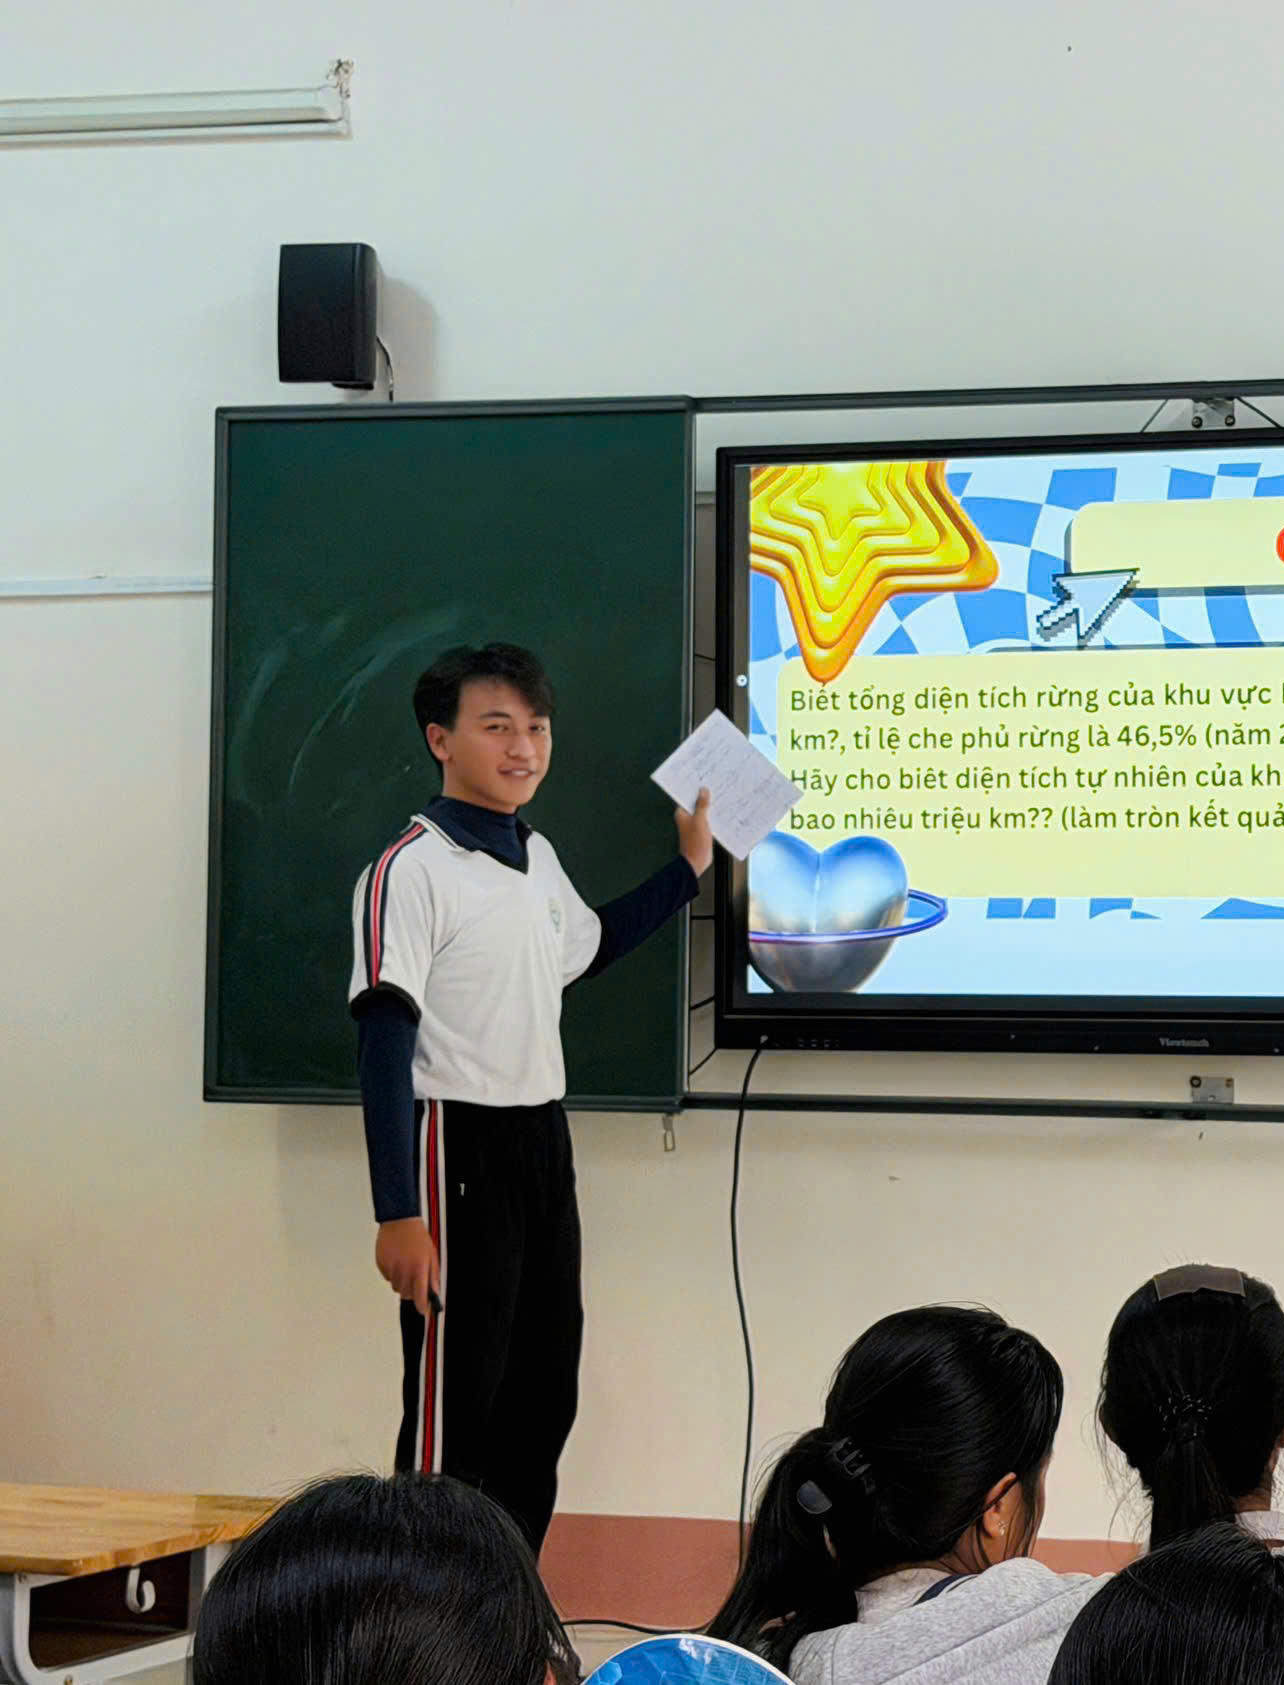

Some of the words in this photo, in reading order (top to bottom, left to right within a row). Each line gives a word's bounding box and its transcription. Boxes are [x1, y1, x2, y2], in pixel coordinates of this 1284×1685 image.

[848, 685, 905, 715] tổng
[914, 687, 969, 715] diện
[978, 687, 1026, 709] tích
[1037, 685, 1099, 713] rừng
[1108, 681, 1155, 706] của
[1165, 683, 1210, 706] khu
[1220, 685, 1272, 710] vực
[791, 729, 846, 755] km?,
[853, 726, 872, 749] tỉ
[879, 727, 900, 755] lệ
[908, 727, 953, 750] che
[961, 724, 1010, 754] phủ
[1018, 726, 1080, 754] rừng
[1088, 724, 1110, 747] là
[1117, 724, 1197, 751] 46,5%
[1205, 723, 1270, 748] (năm
[791, 769, 838, 796] Hãy
[845, 768, 890, 790] cho
[956, 767, 1011, 794] diện
[1019, 766, 1067, 789] tích
[1075, 768, 1107, 794] tự
[1114, 765, 1186, 788] nhiên
[1196, 762, 1243, 787] của
[791, 808, 835, 830] bao
[844, 808, 913, 830] nhiêu
[921, 807, 981, 834] triệu
[990, 807, 1052, 829] km??
[1060, 805, 1117, 830] (làm
[1126, 805, 1179, 828] tròn
[1189, 799, 1229, 828] kết
